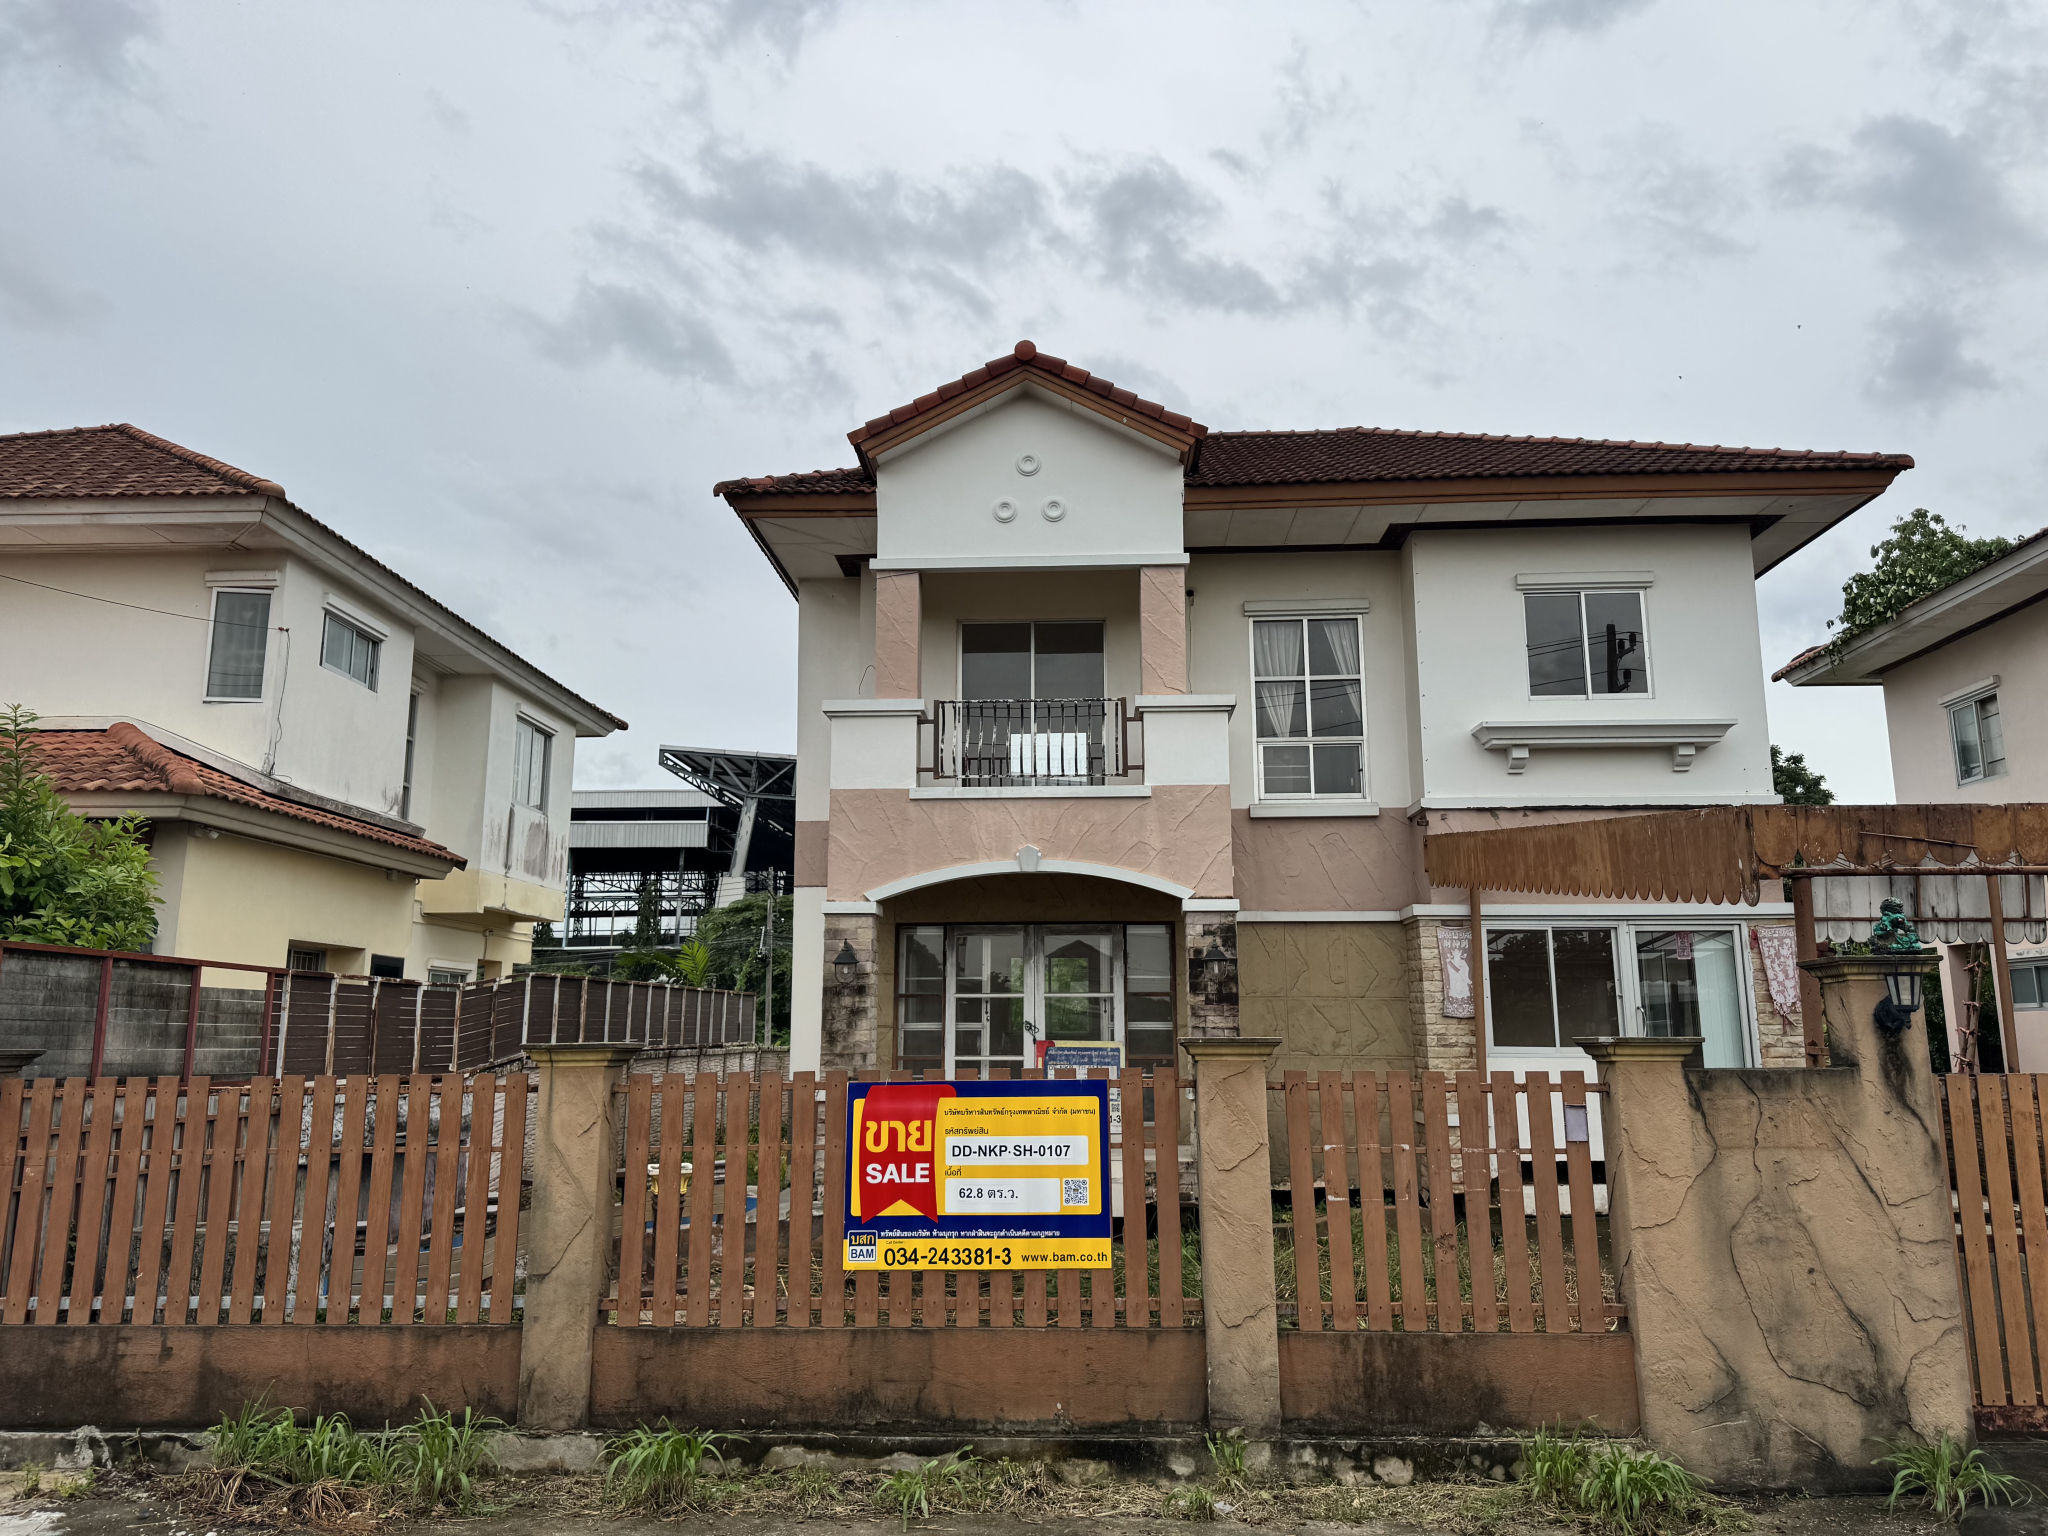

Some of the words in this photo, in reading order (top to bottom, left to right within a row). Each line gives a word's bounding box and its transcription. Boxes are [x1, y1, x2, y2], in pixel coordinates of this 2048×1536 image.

[1052, 1107, 1068, 1115] จำกัด
[865, 1119, 932, 1153] ขาย
[944, 1126, 989, 1135] รหัสทรัพย์สิน
[865, 1163, 930, 1184] SALE
[944, 1166, 962, 1176] เนื้อที่
[959, 1187, 984, 1199] 62.8
[987, 1188, 1019, 1199] ตร.ว.
[850, 1233, 875, 1245] บสก
[850, 1248, 874, 1259] BAM
[884, 1247, 1012, 1266] 034-243381-3
[1021, 1251, 1108, 1262] www.bam.co.th
